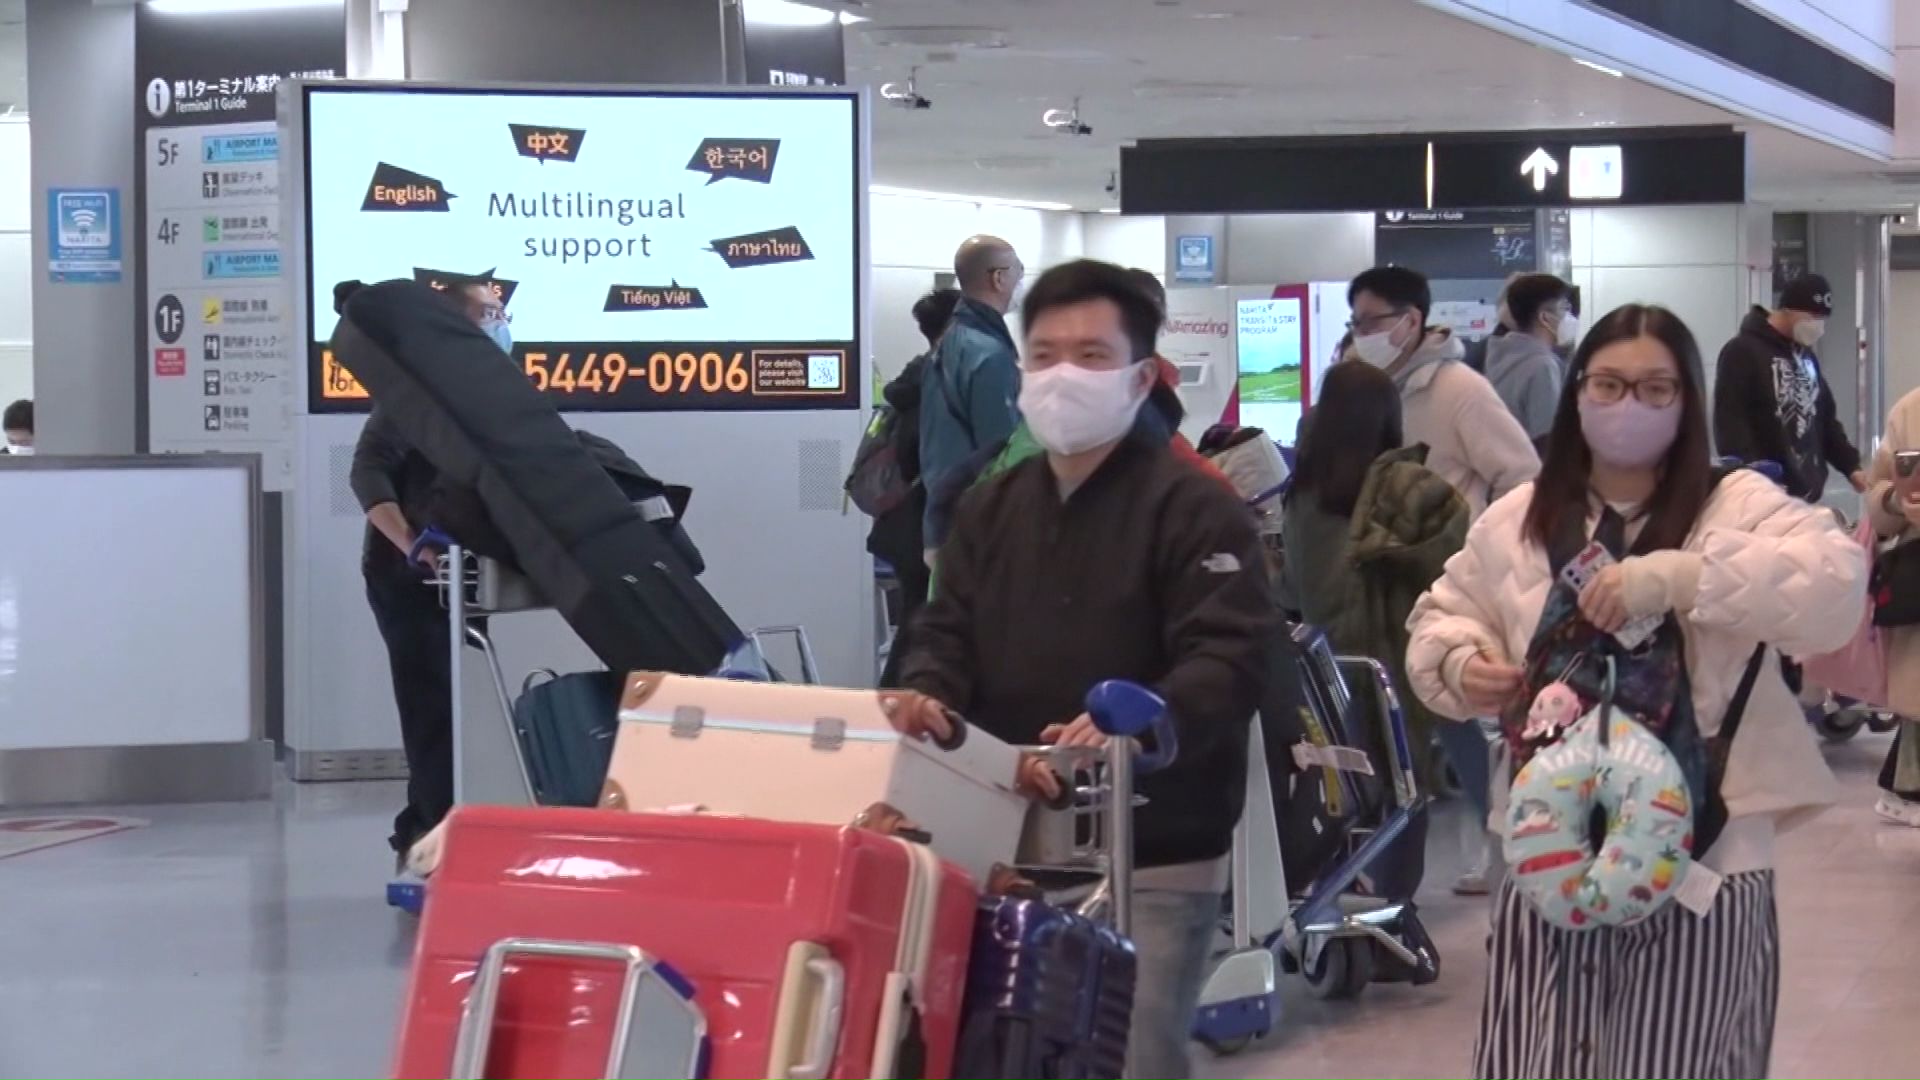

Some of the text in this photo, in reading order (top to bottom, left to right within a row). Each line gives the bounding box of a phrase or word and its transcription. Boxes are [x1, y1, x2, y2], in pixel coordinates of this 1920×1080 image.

[175, 99, 212, 113] Terminal
[220, 96, 248, 111] Guide
[157, 137, 179, 166] 5F
[527, 131, 569, 154] 中文
[704, 145, 768, 170] 한국어
[374, 185, 437, 206] English
[488, 191, 685, 226] Multilingual
[157, 217, 180, 244] 4F
[524, 234, 651, 264] support
[727, 238, 801, 257] ภาษาไทย
[621, 289, 691, 306] Tiếng Việt
[160, 305, 181, 333] 1F
[524, 352, 749, 393] 5449-0906
[759, 359, 773, 369] For
[759, 369, 786, 379] please
[759, 379, 773, 387] our
